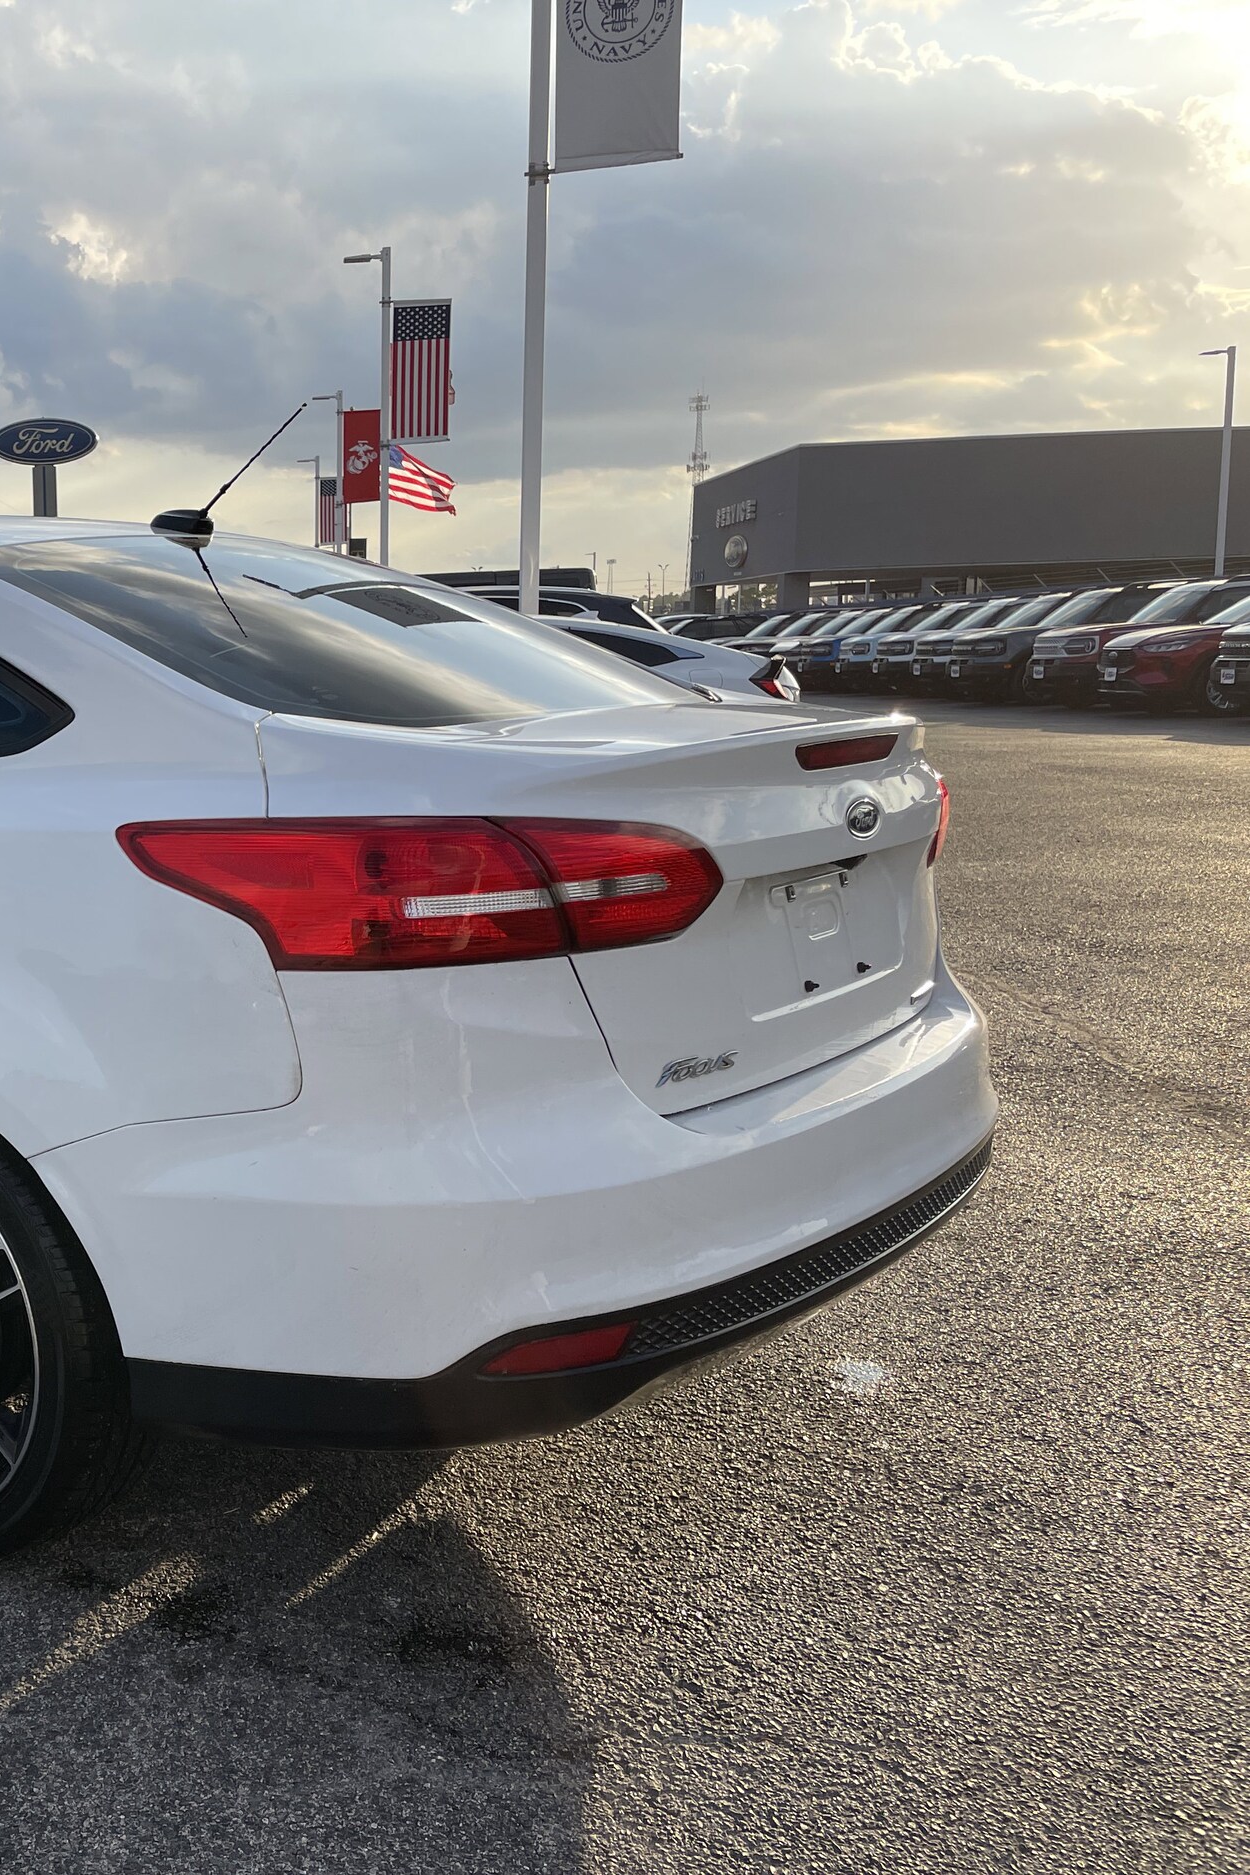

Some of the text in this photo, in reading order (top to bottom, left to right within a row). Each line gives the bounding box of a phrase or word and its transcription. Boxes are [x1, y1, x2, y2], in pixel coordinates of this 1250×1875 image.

[590, 33, 647, 57] NAVY
[13, 428, 75, 454] Ford
[715, 499, 757, 529] SERVICE
[655, 1049, 739, 1088] Focus
